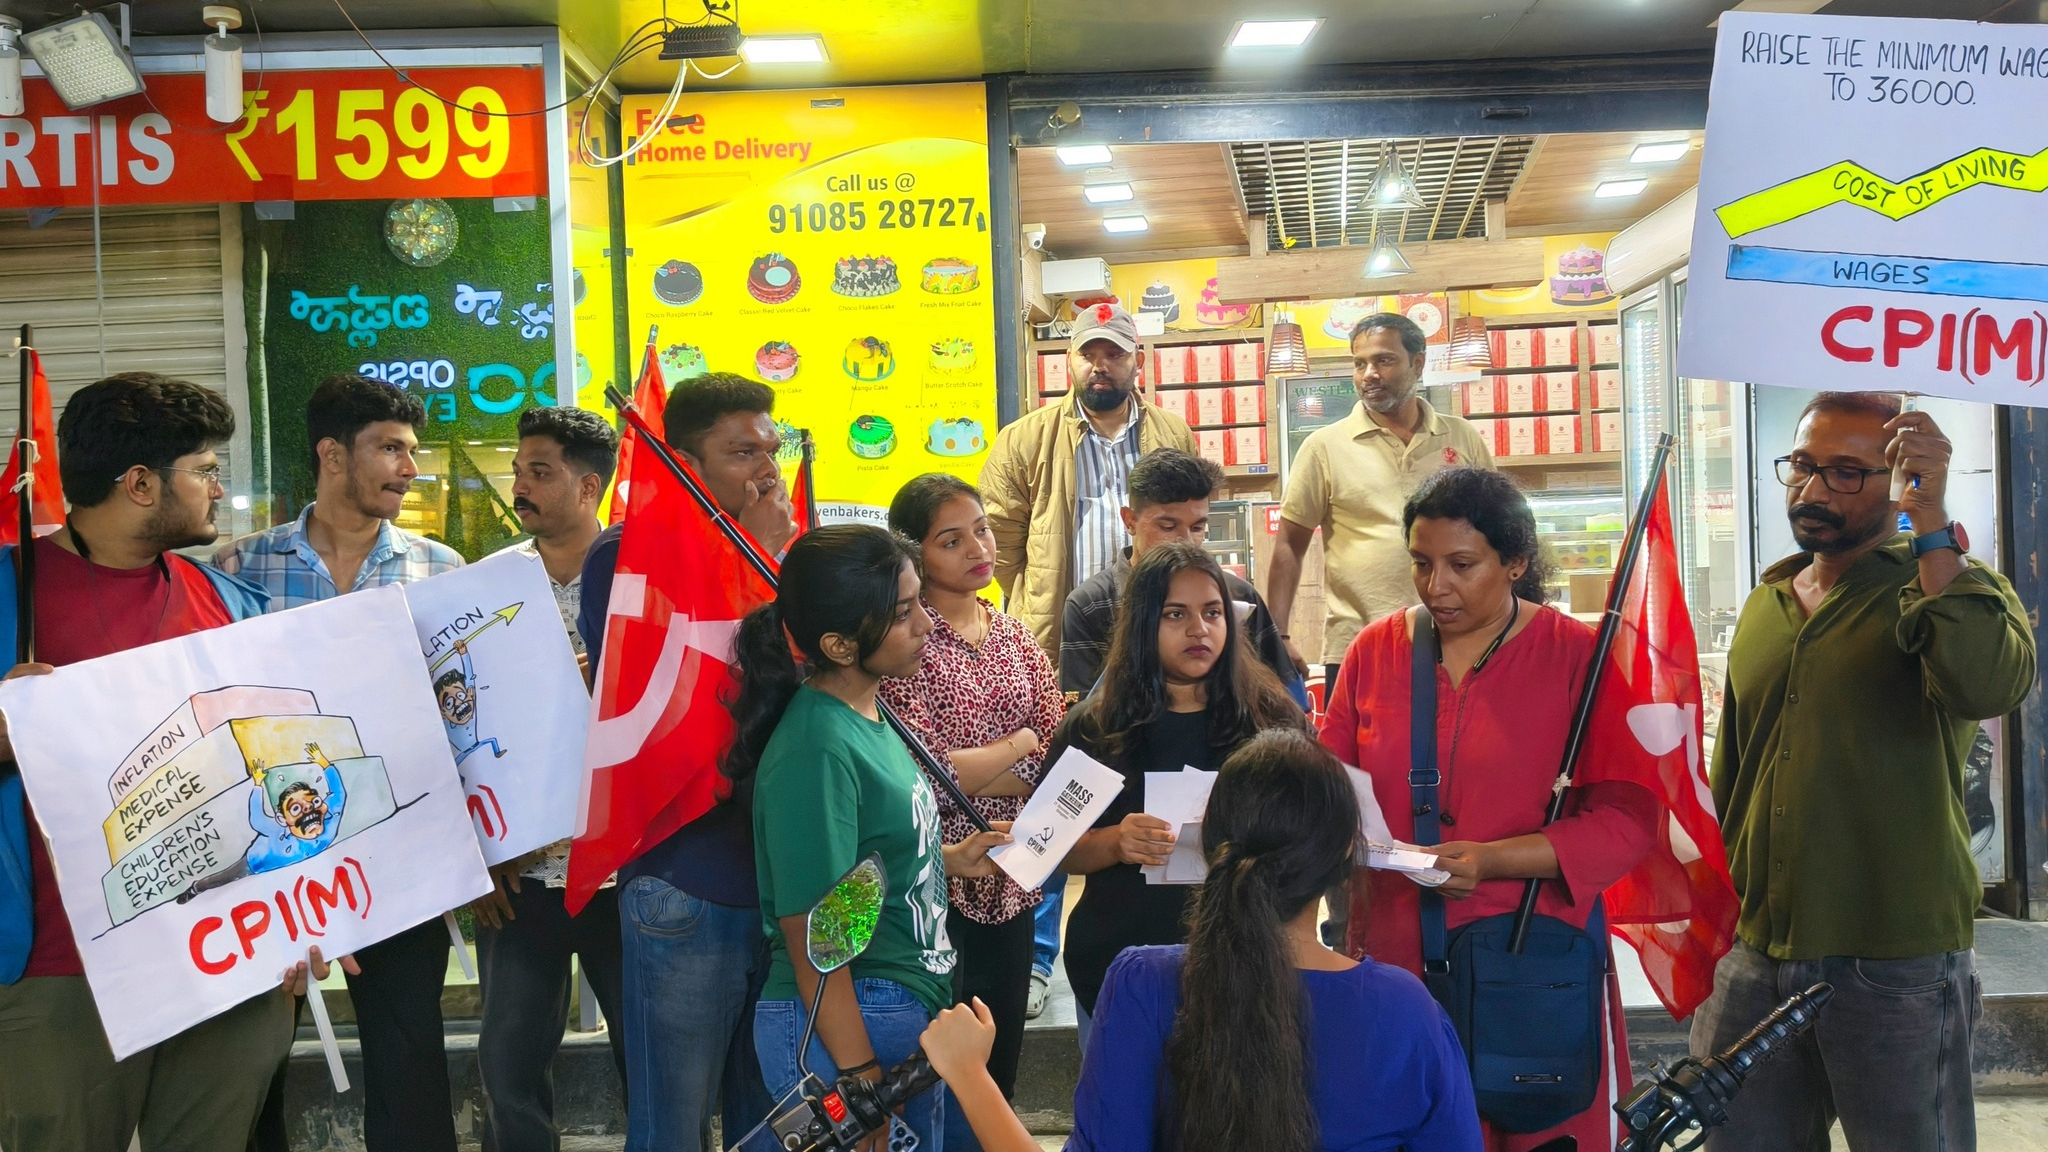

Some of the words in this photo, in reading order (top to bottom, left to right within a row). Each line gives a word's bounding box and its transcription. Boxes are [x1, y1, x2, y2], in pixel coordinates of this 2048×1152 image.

[1741, 30, 1811, 66] RAISE
[1822, 36, 1866, 69] THE
[1878, 41, 1989, 75] MINIMUM
[1824, 72, 1856, 101] TO
[1867, 76, 1977, 106] 36000.
[636, 109, 705, 136] Free
[0, 112, 175, 188] RTIS
[637, 142, 706, 163] Home
[714, 137, 812, 163] Delivery
[826, 174, 861, 192] Call
[867, 176, 888, 191] us
[895, 172, 916, 192] @
[1833, 170, 1896, 208] COST
[1905, 179, 1933, 205] OF
[1942, 155, 2026, 190] LIVING
[768, 202, 866, 234] 91085
[878, 197, 975, 229] 28727
[1833, 260, 1930, 285] WAGES
[1821, 305, 2047, 389] CPI(M)
[113, 724, 186, 796] INFLATION
[118, 766, 191, 824] MEDICAL
[124, 774, 206, 842] EXPENSE
[1065, 779, 1094, 804] MASS
[120, 811, 214, 880] CHILDREN'S
[124, 828, 221, 896] EDUCATION
[1026, 836, 1046, 856] CPI(M)
[131, 851, 218, 908] EXPENSE
[189, 856, 372, 975] CPI(M)
